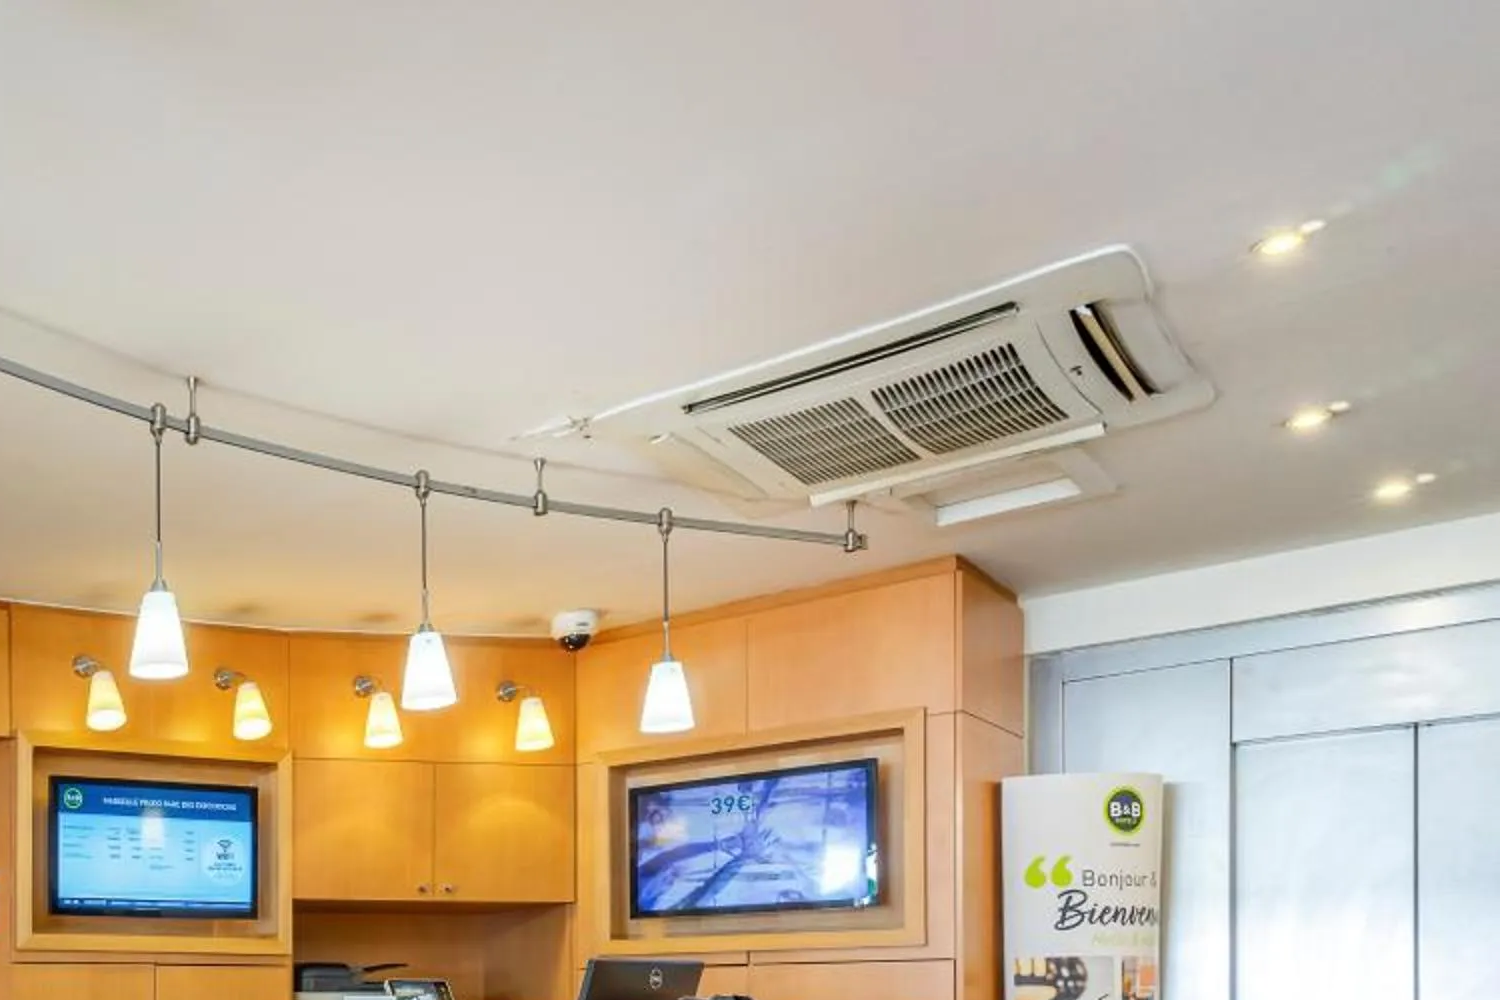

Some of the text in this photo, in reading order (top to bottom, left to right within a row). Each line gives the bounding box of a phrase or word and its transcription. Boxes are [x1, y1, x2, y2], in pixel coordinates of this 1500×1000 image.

[711, 795, 751, 815] 39€
[1110, 801, 1141, 817] B&B
[1082, 869, 1148, 891] Bonjour
